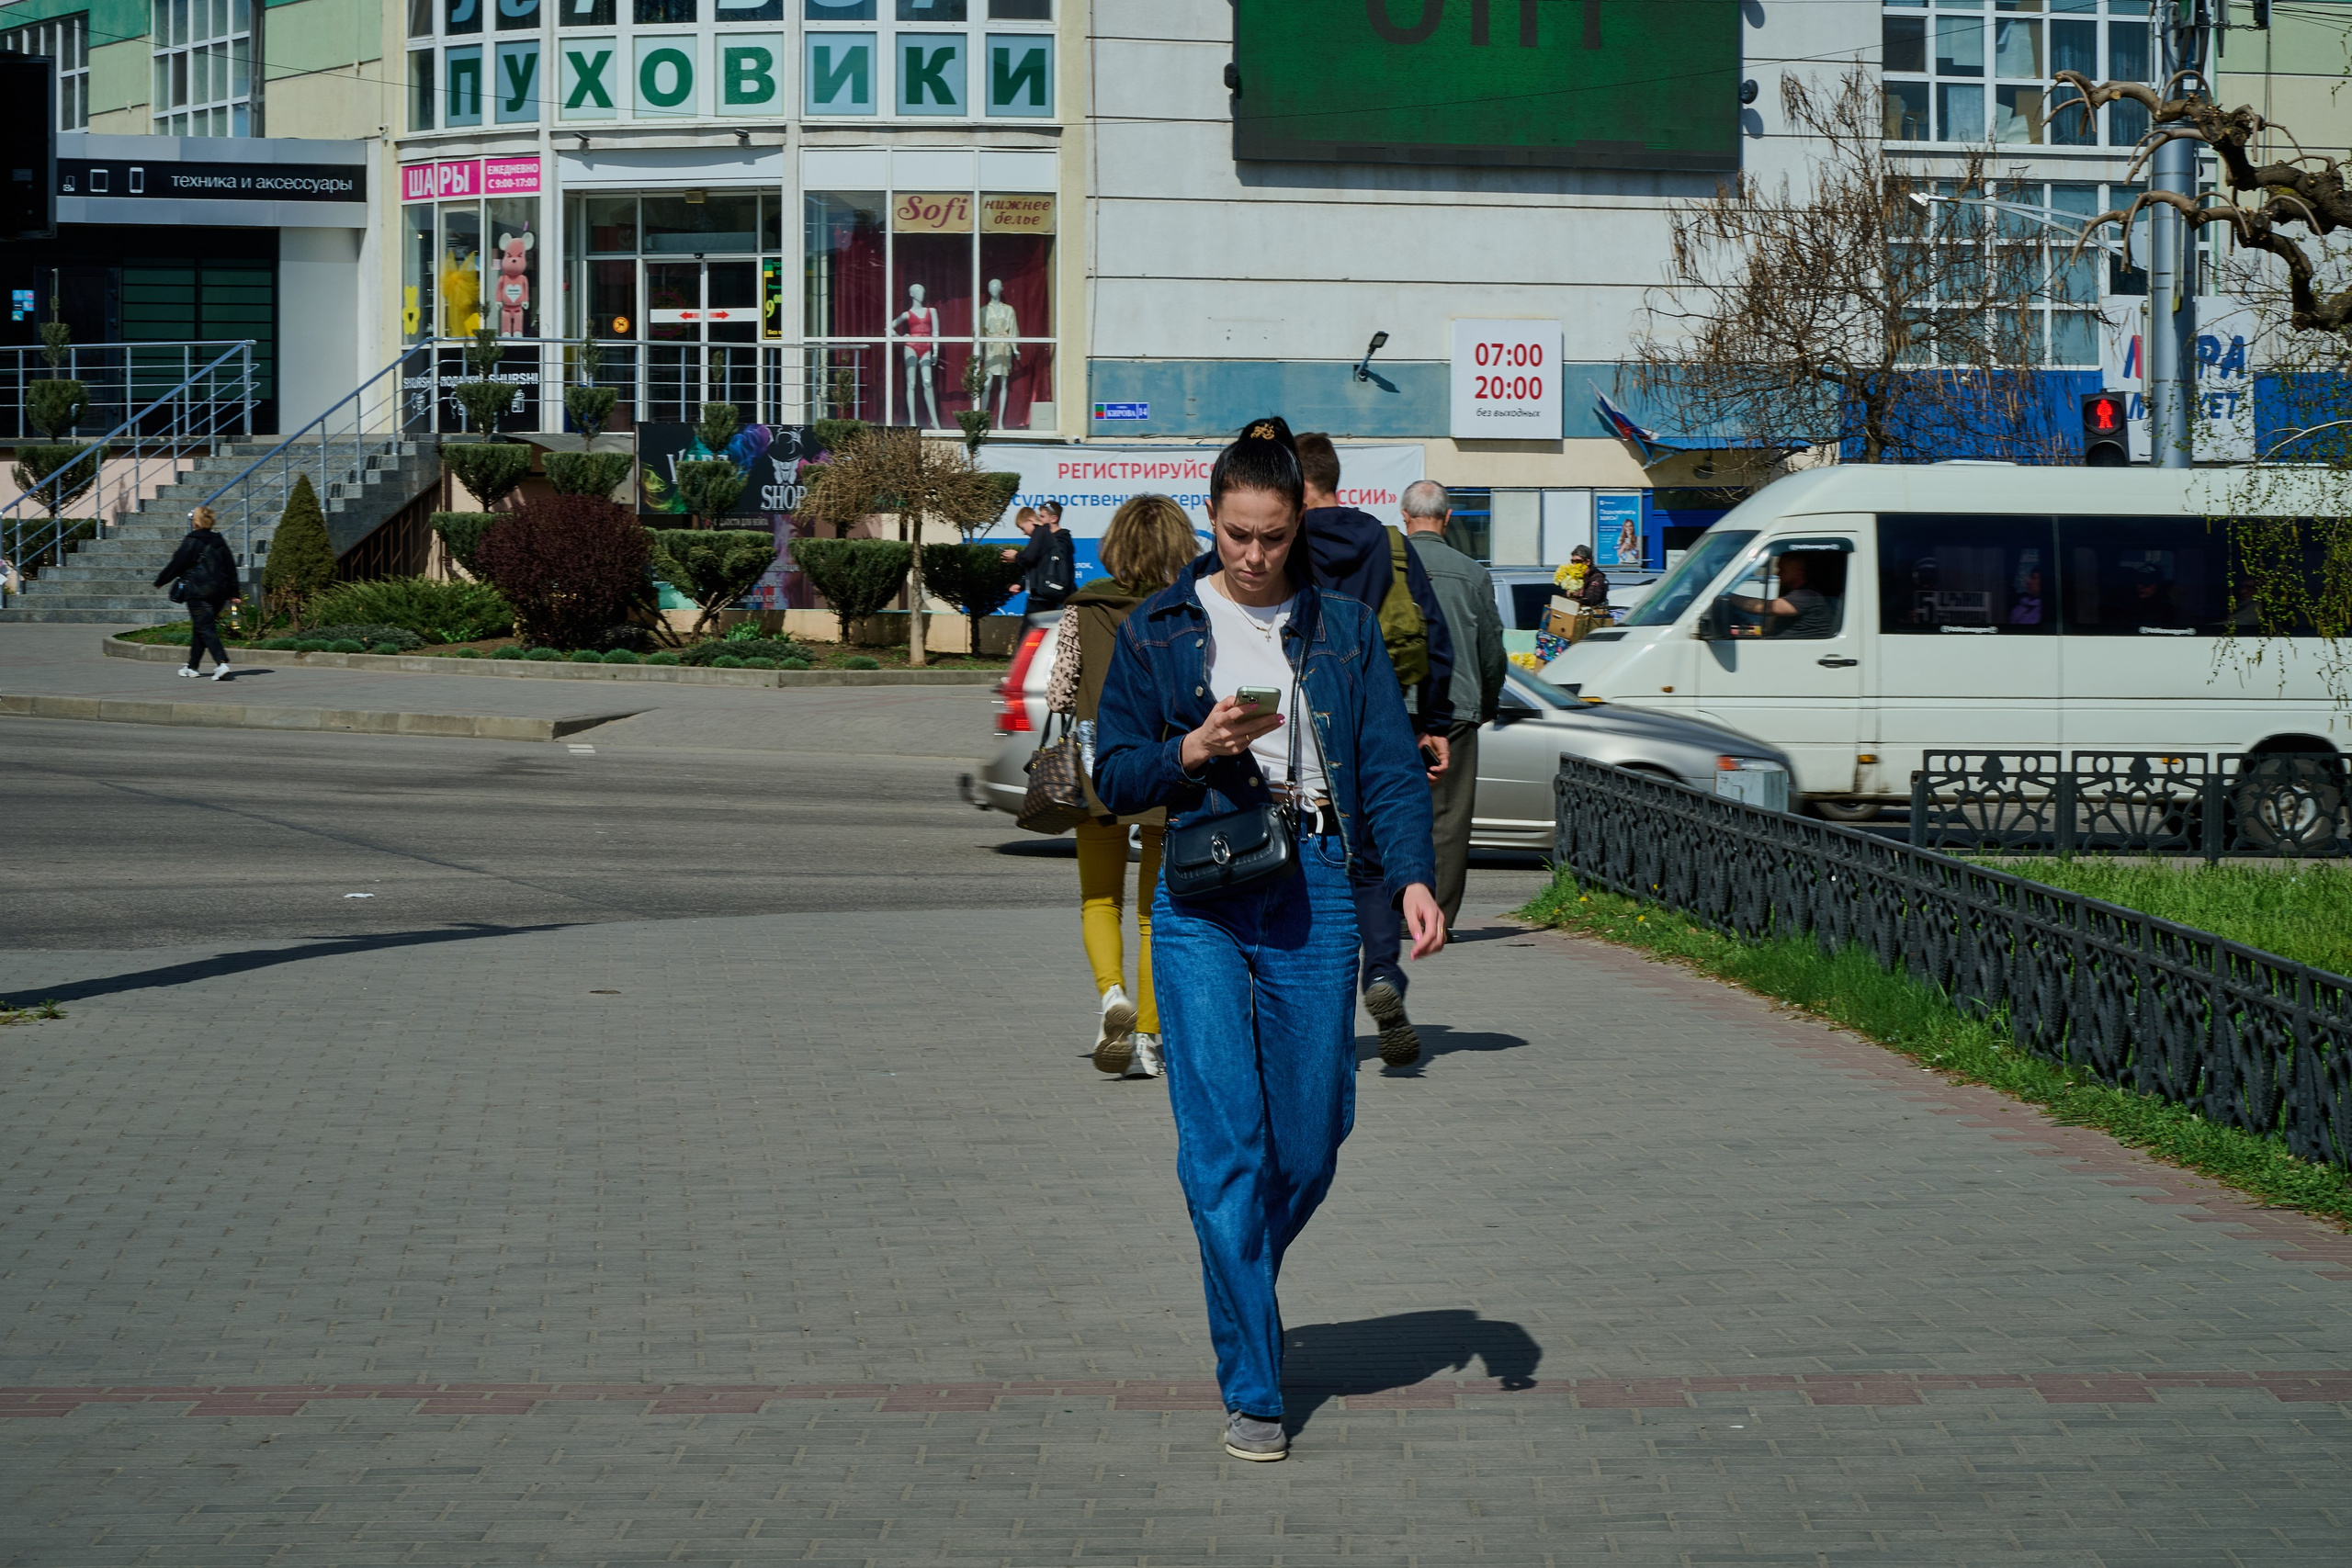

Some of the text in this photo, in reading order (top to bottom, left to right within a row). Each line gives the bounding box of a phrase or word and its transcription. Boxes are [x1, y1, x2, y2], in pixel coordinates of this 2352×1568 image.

[450, 45, 1046, 117] ПУХОВИКИ
[487, 164, 539, 175] ЕЖЕДНЕВНО
[171, 175, 353, 193] техника и аксессуары
[408, 164, 469, 197] ШАРЫ
[897, 196, 967, 228] Sofi
[984, 199, 1051, 210] нижнее
[994, 211, 1041, 225] белье
[1475, 343, 1543, 367] 07:00
[403, 377, 432, 389] SHURSH
[1475, 376, 1543, 400] 20:00
[1476, 408, 1541, 417] без выходных
[761, 485, 808, 511] SHOP
[1012, 493, 1129, 509] сударствен
[1336, 489, 1396, 504] ССИИ»
